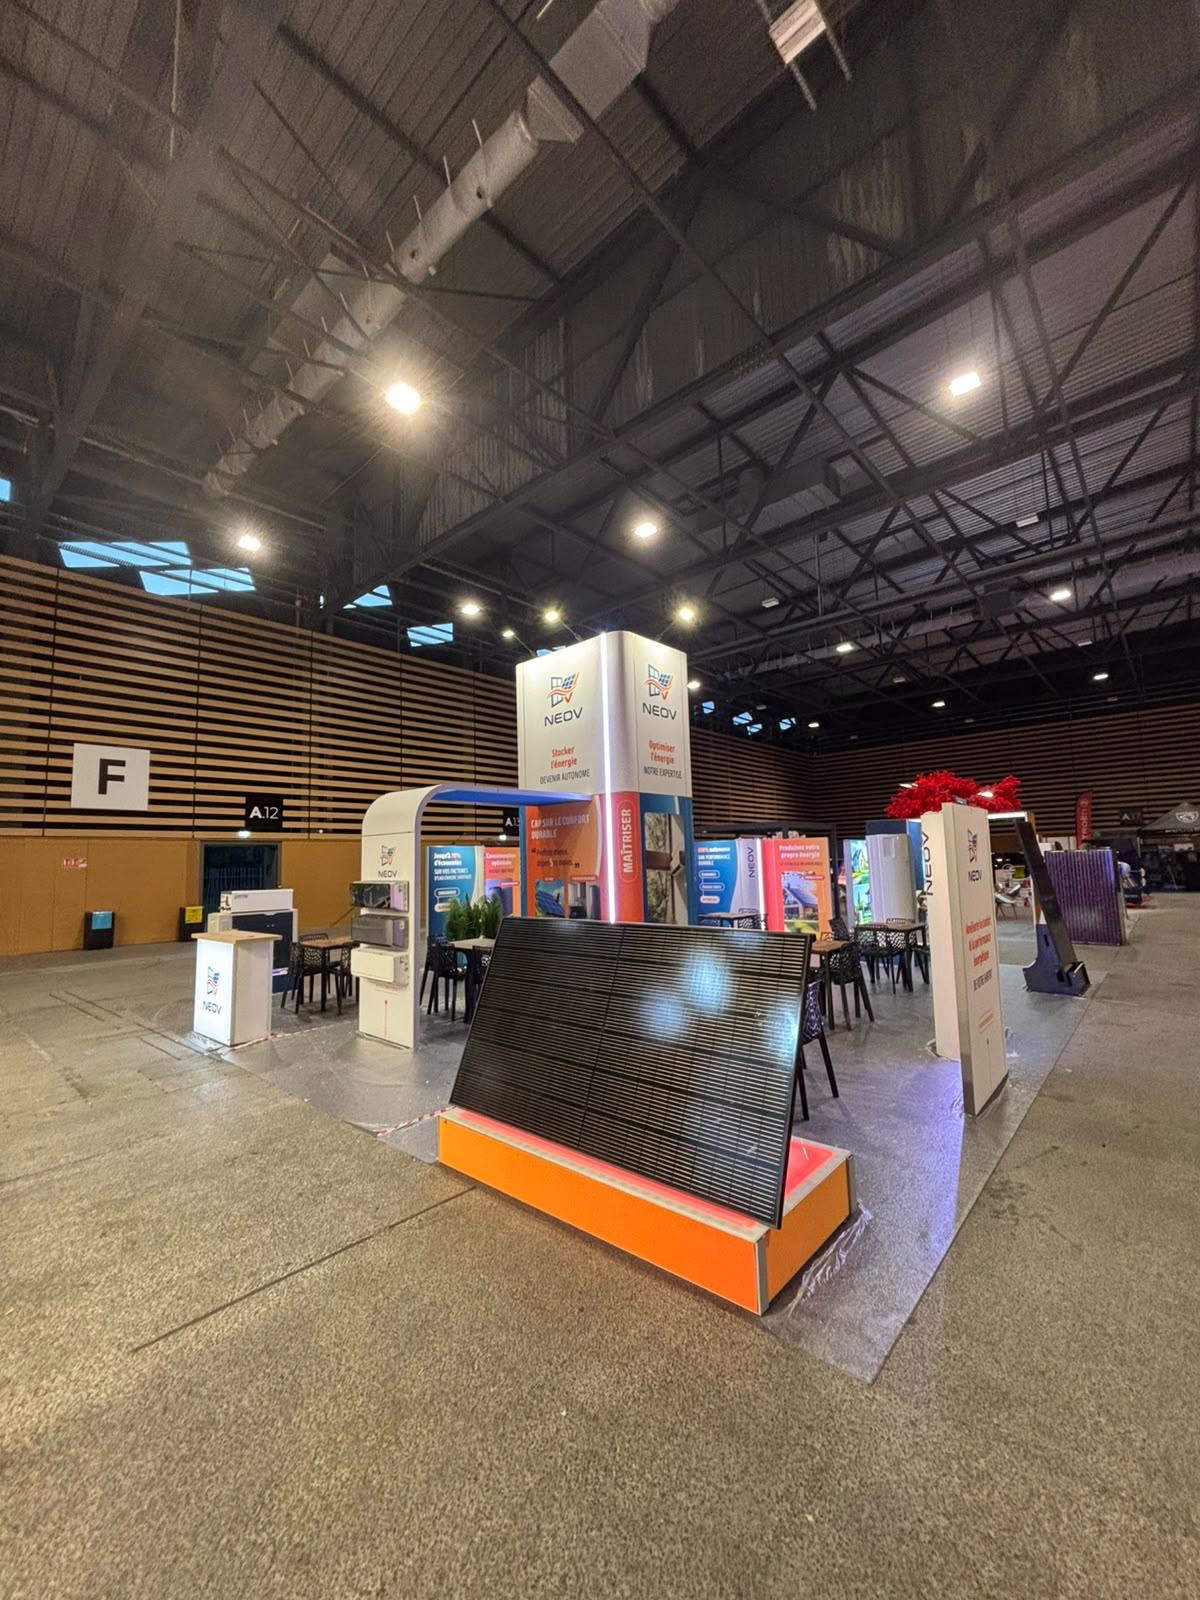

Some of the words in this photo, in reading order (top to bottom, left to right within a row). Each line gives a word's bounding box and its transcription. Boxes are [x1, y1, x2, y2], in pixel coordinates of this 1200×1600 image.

[544, 706, 583, 727] NEOV
[642, 702, 677, 720] NEOV
[551, 746, 575, 758] Stocker
[648, 740, 675, 752] Optimiser
[550, 757, 577, 769] l'énergie
[98, 758, 126, 795] F
[540, 774, 561, 784] DEVENIR
[561, 769, 590, 781] AUTONOME
[249, 805, 279, 819] A.12
[620, 808, 633, 873] MAÎTRISER
[746, 846, 755, 878] NEOV
[921, 831, 933, 896] NEOV
[378, 870, 398, 878] NEOV
[967, 869, 982, 882] NEOV
[202, 1000, 222, 1015] NEOV
